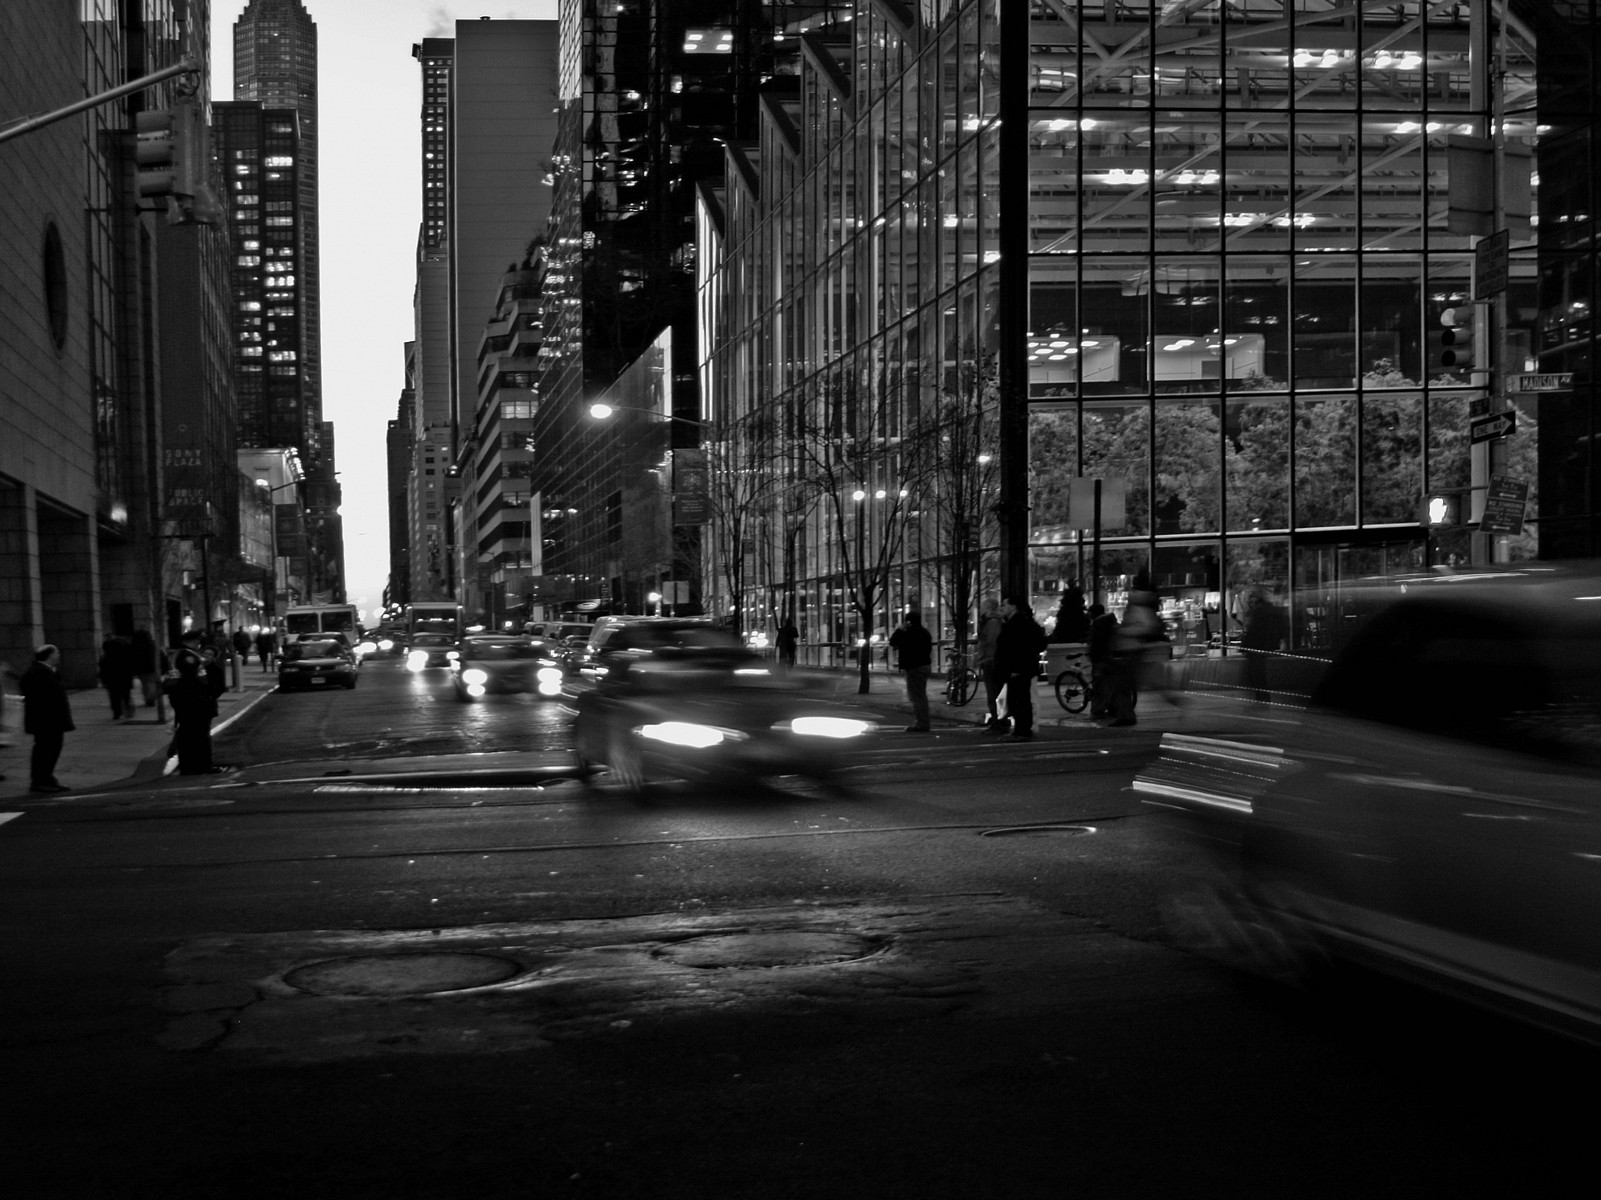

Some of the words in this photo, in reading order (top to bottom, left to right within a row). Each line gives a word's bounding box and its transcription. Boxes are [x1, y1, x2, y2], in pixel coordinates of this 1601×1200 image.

[1522, 376, 1559, 390] MADISON
[1476, 424, 1489, 436] ONE
[1493, 420, 1507, 430] WAY
[165, 449, 202, 458] SONY
[165, 457, 202, 467] PLAZA
[169, 488, 204, 497] PUBLIC
[168, 497, 203, 506] SPACE
[1498, 501, 1523, 509] STANDING
